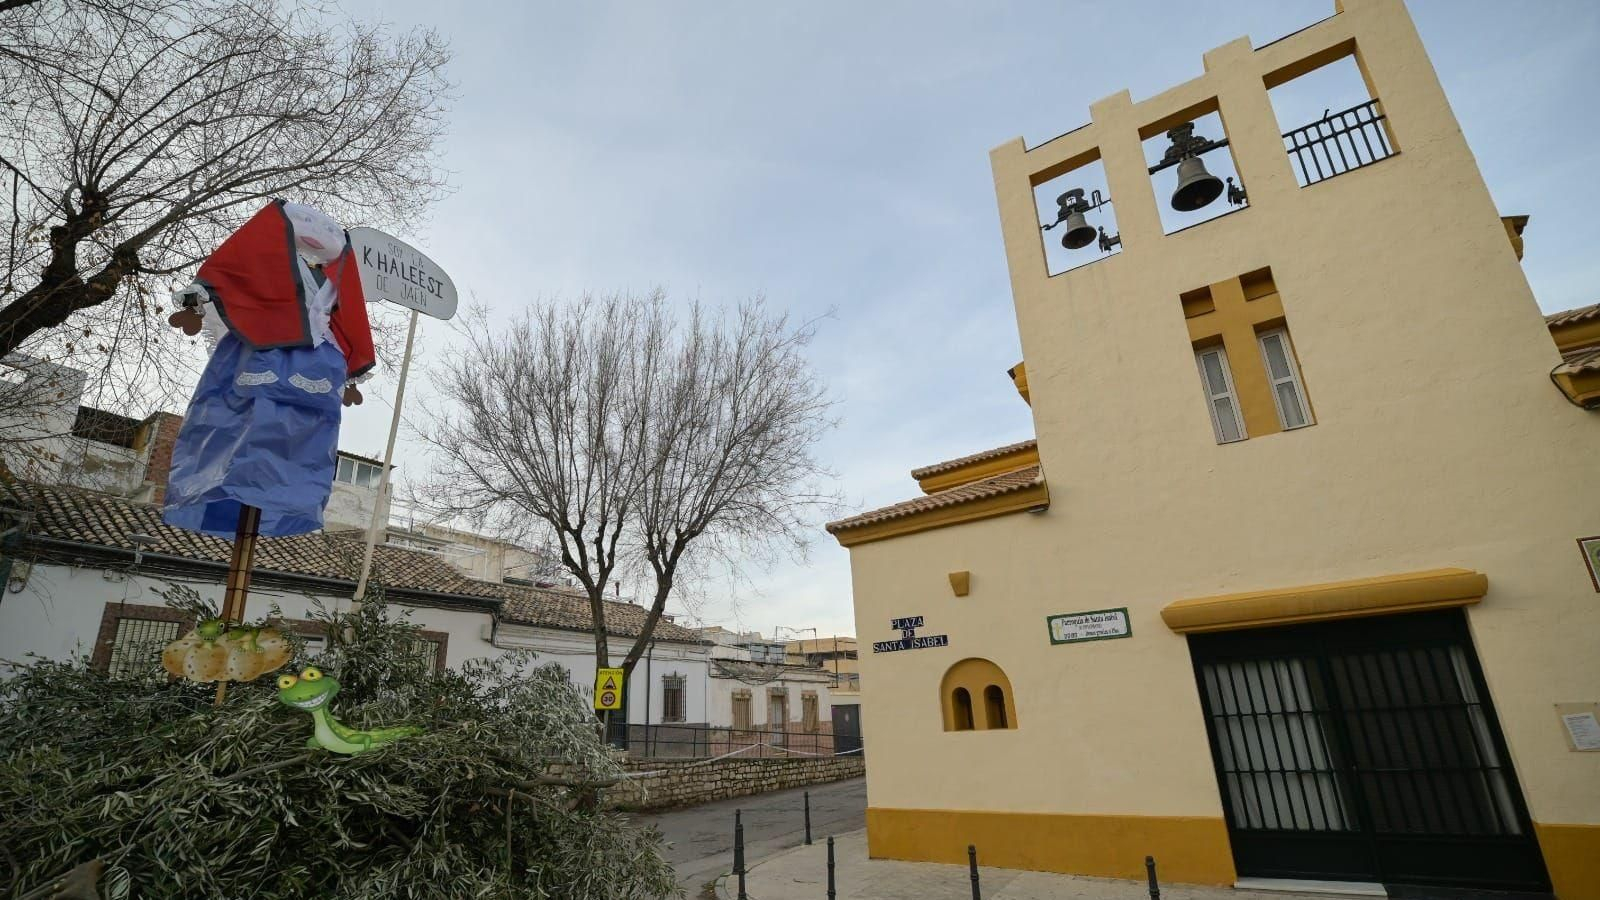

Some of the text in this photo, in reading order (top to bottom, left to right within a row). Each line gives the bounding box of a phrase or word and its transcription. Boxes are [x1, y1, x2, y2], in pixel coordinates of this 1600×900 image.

[363, 245, 444, 299] KHALEESI
[376, 274, 390, 292] DE
[891, 616, 924, 629] PLAZA
[902, 629, 914, 639] DE
[873, 636, 947, 653] SANTA ISABEL
